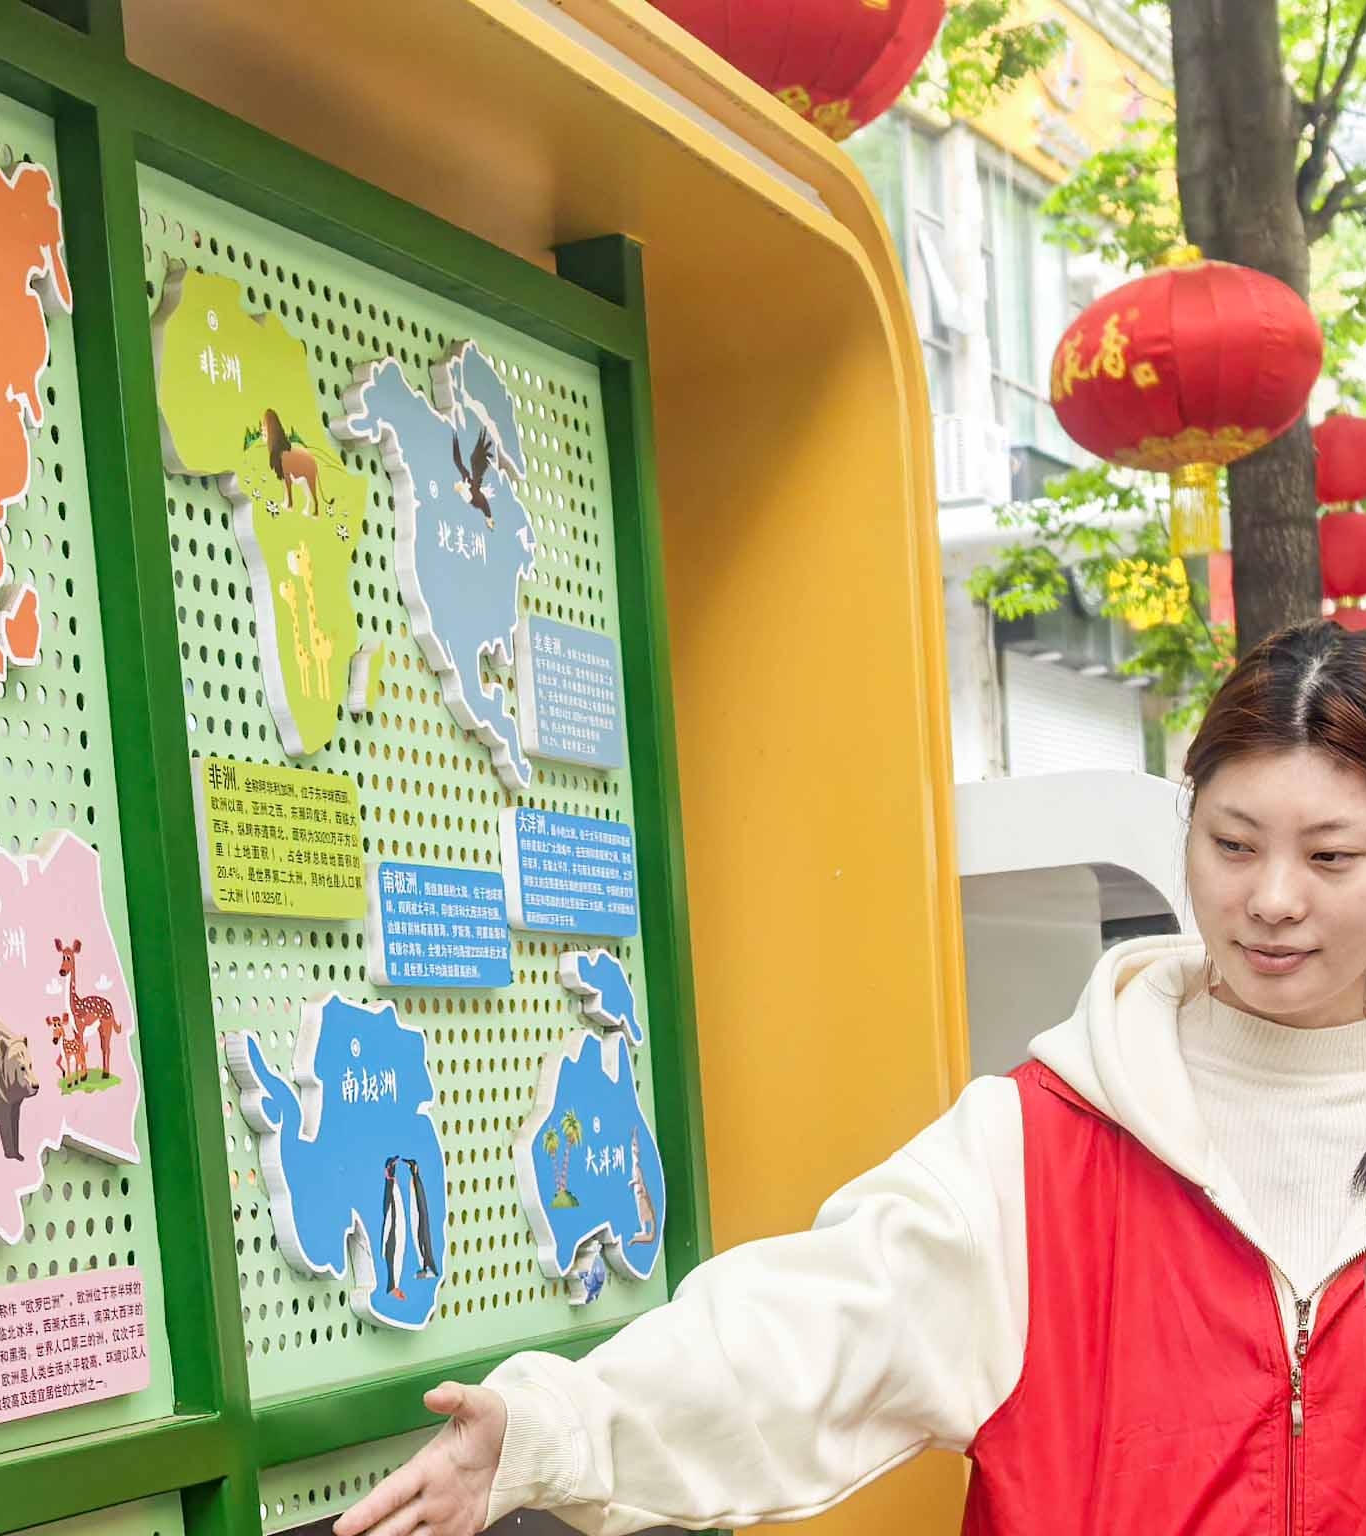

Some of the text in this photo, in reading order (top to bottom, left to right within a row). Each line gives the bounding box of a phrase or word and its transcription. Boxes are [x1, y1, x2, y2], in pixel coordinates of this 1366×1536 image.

[199, 344, 243, 392] 非洲
[438, 521, 487, 565] 北美洲
[341, 1066, 398, 1104] 南极洲
[584, 1144, 626, 1177] 大洋洲
